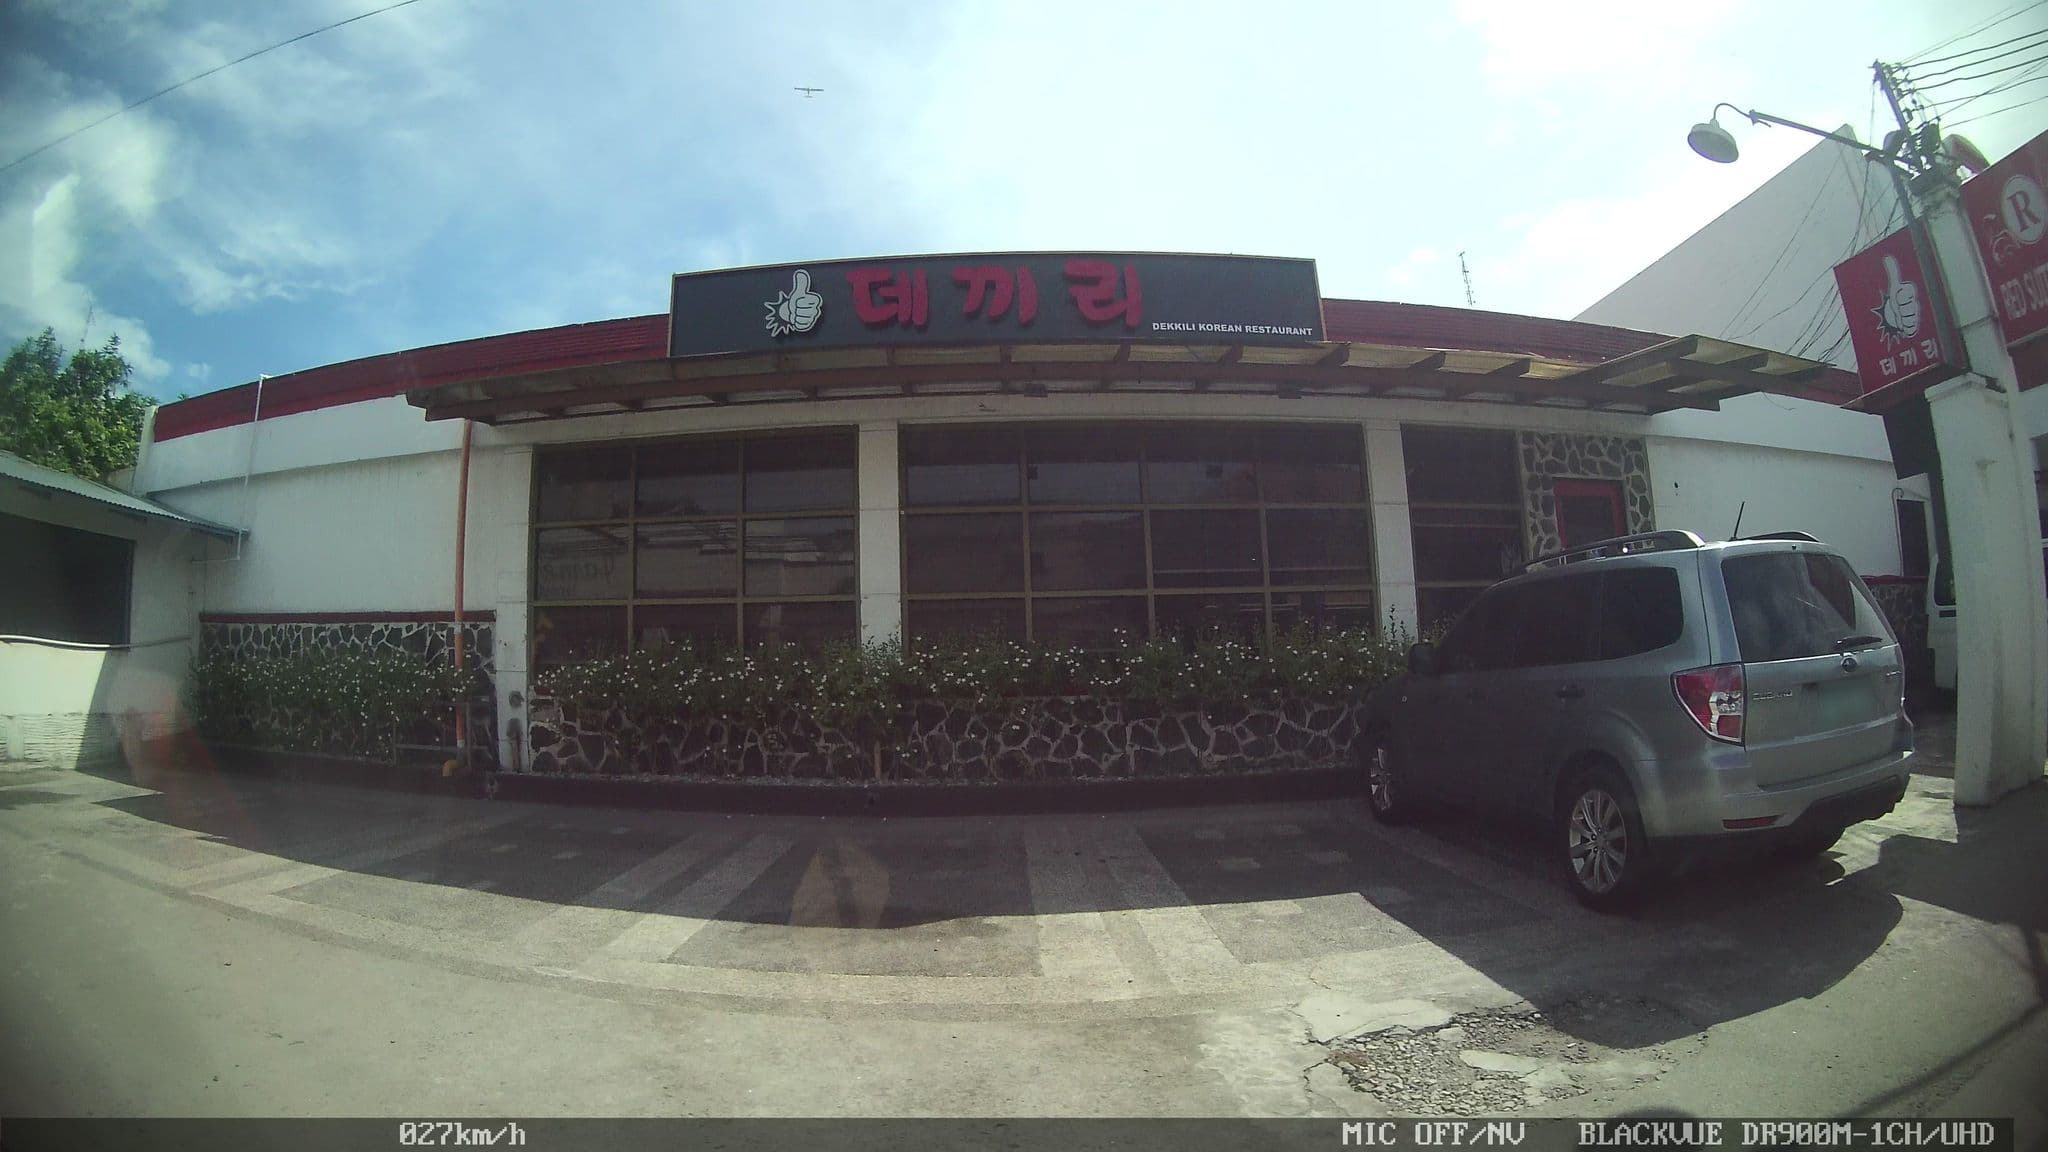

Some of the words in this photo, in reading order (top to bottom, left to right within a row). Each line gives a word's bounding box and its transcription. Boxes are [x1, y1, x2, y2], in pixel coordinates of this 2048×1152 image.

[2007, 189, 2040, 232] R
[1152, 322, 1196, 331] DEKKILI
[1199, 323, 1242, 333] KOREAN
[1245, 325, 1313, 336] RESTAURANT
